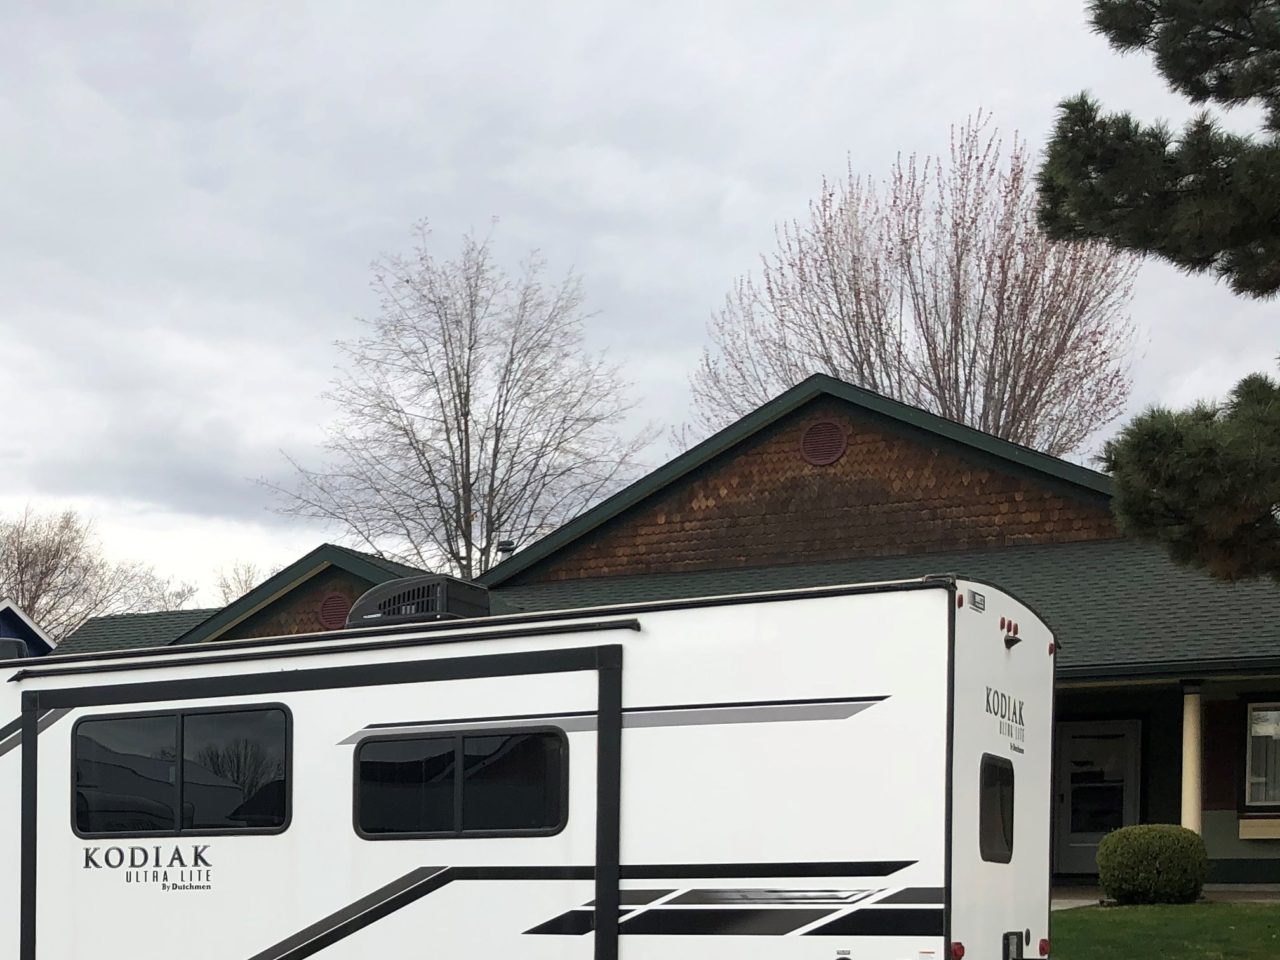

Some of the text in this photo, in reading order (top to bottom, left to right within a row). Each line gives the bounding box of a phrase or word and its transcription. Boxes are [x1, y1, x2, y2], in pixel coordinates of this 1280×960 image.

[985, 686, 1024, 727] KODIAK
[83, 845, 212, 868] KODIAK
[125, 870, 211, 882] ULTRA LITE
[162, 882, 212, 891] By Dutchmen
